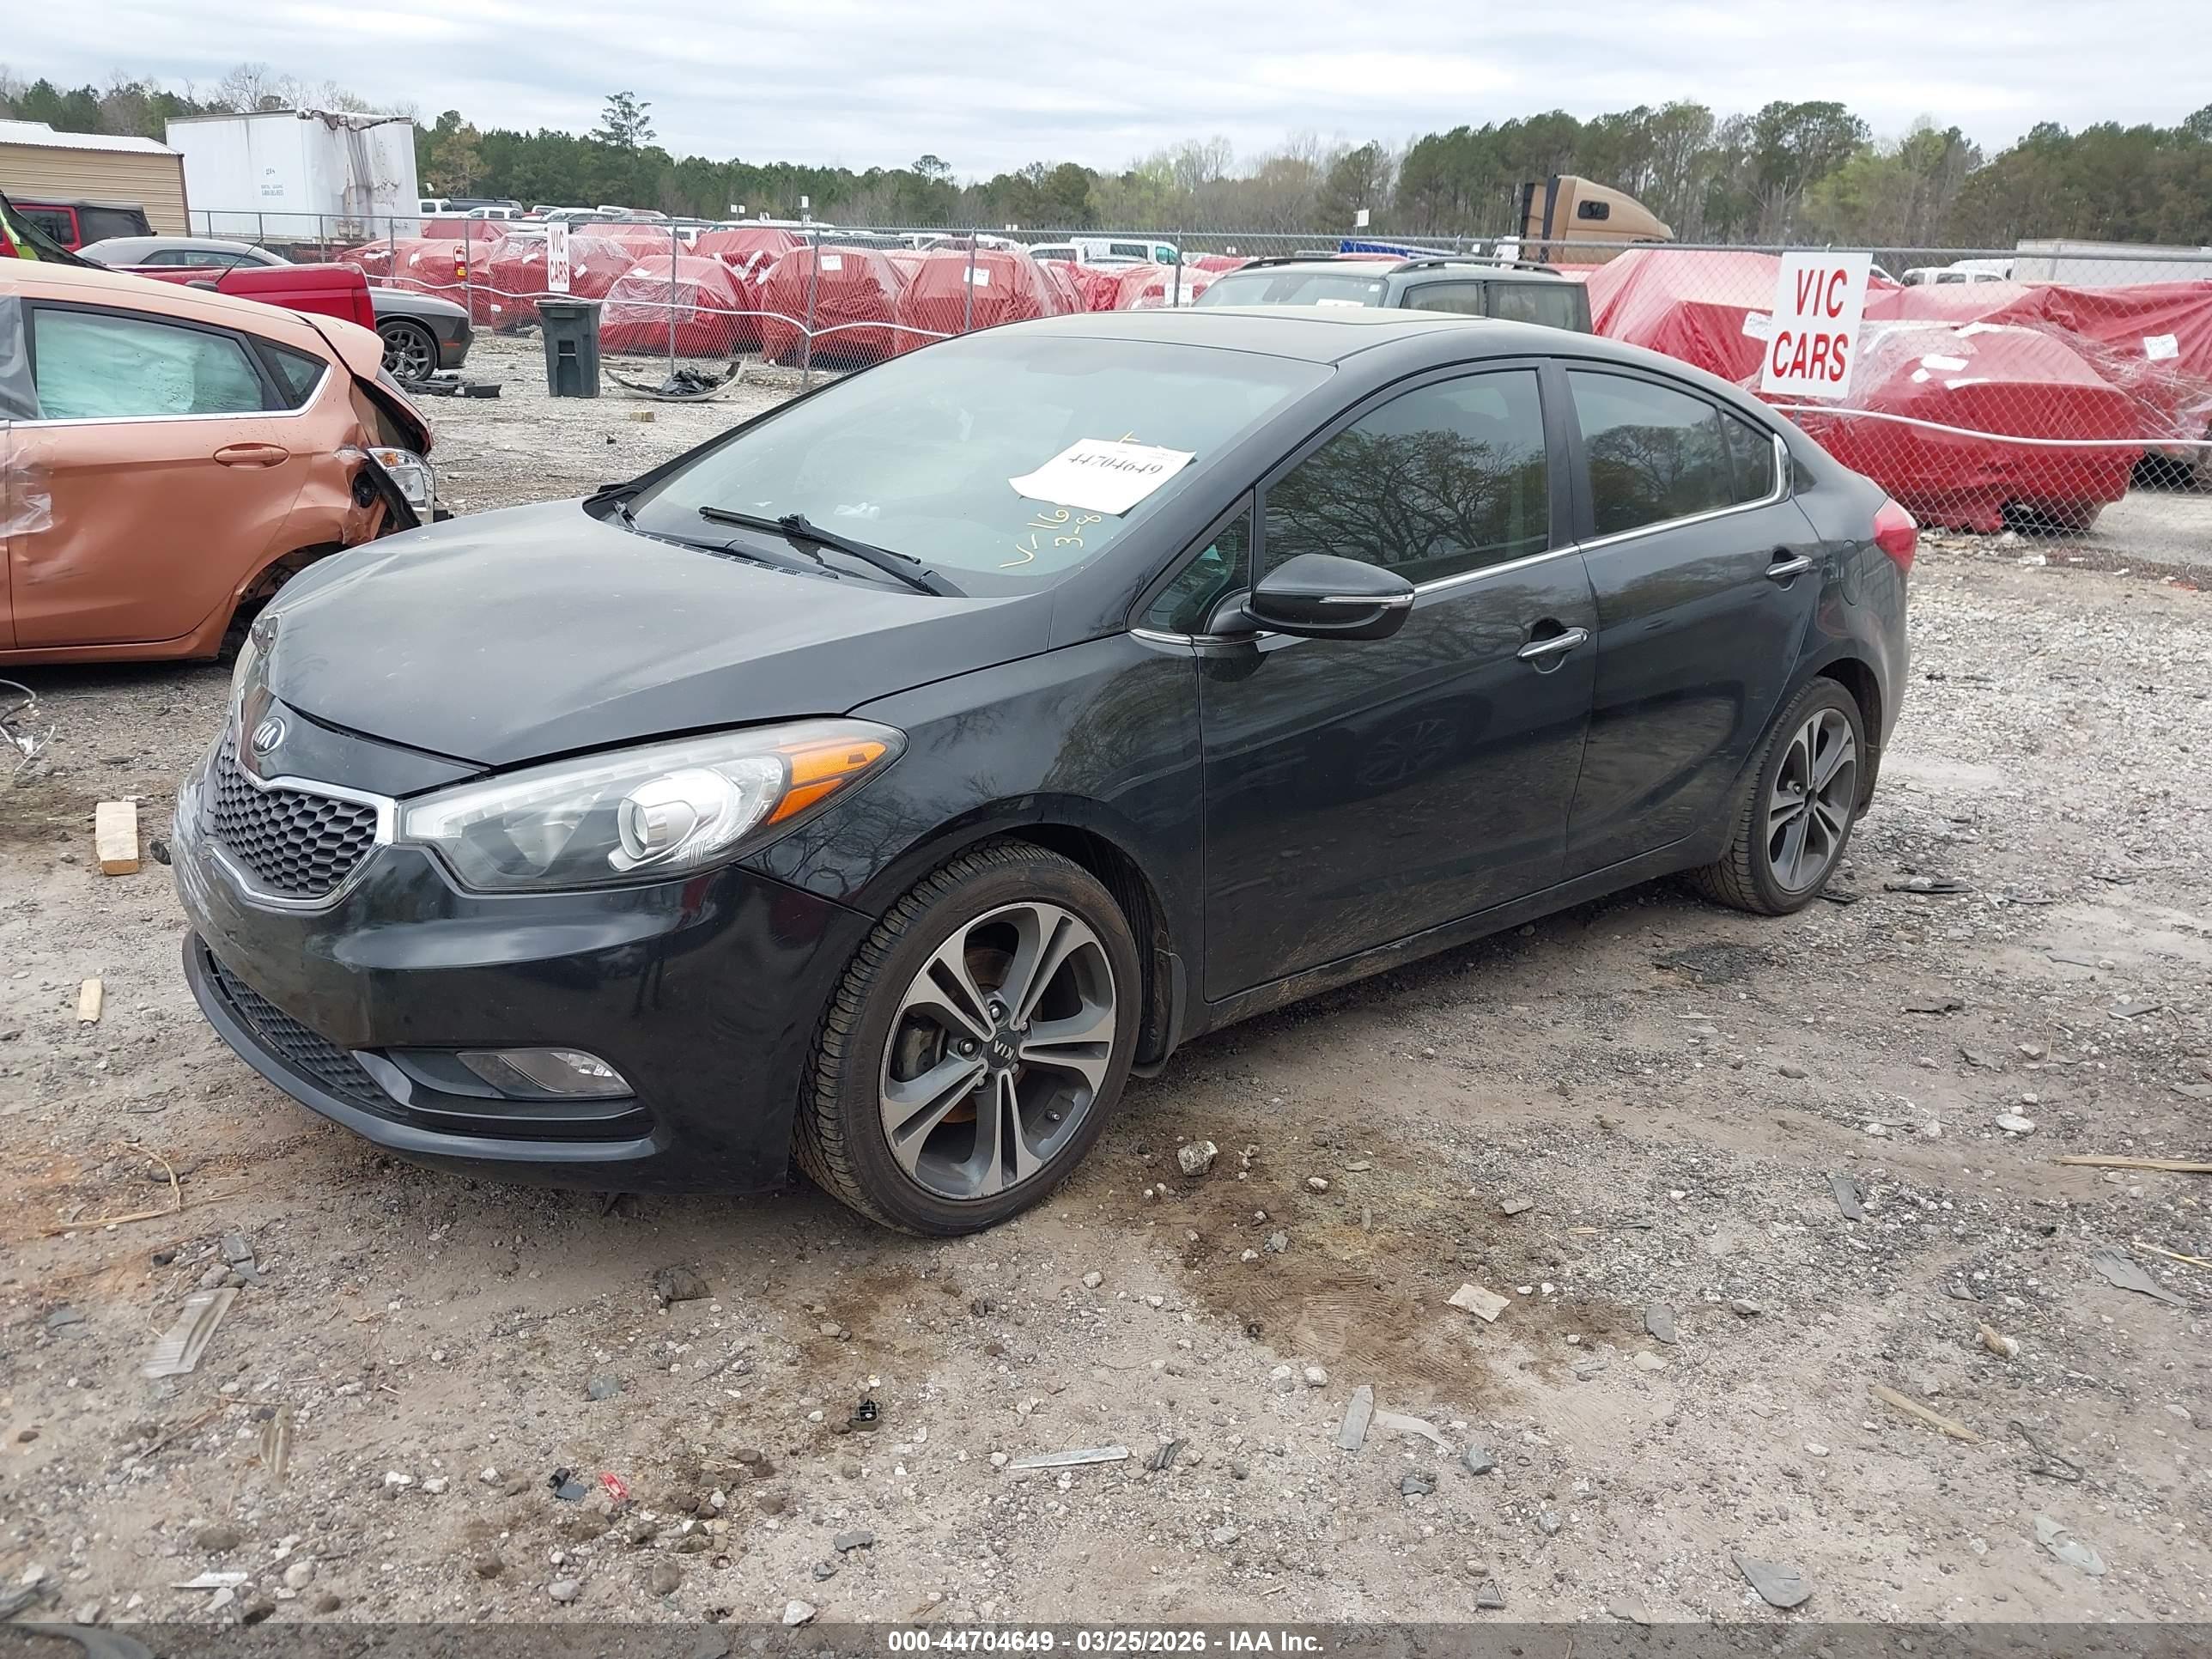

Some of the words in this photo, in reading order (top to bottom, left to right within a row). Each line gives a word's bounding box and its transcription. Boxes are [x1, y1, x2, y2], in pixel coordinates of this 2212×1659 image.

[550, 229, 564, 254] VIC
[550, 260, 568, 284] CARS
[1796, 269, 1848, 318] VIC
[1771, 331, 1849, 382] CARS
[1068, 453, 1164, 474] 44704649
[994, 1039, 1015, 1060] KIA
